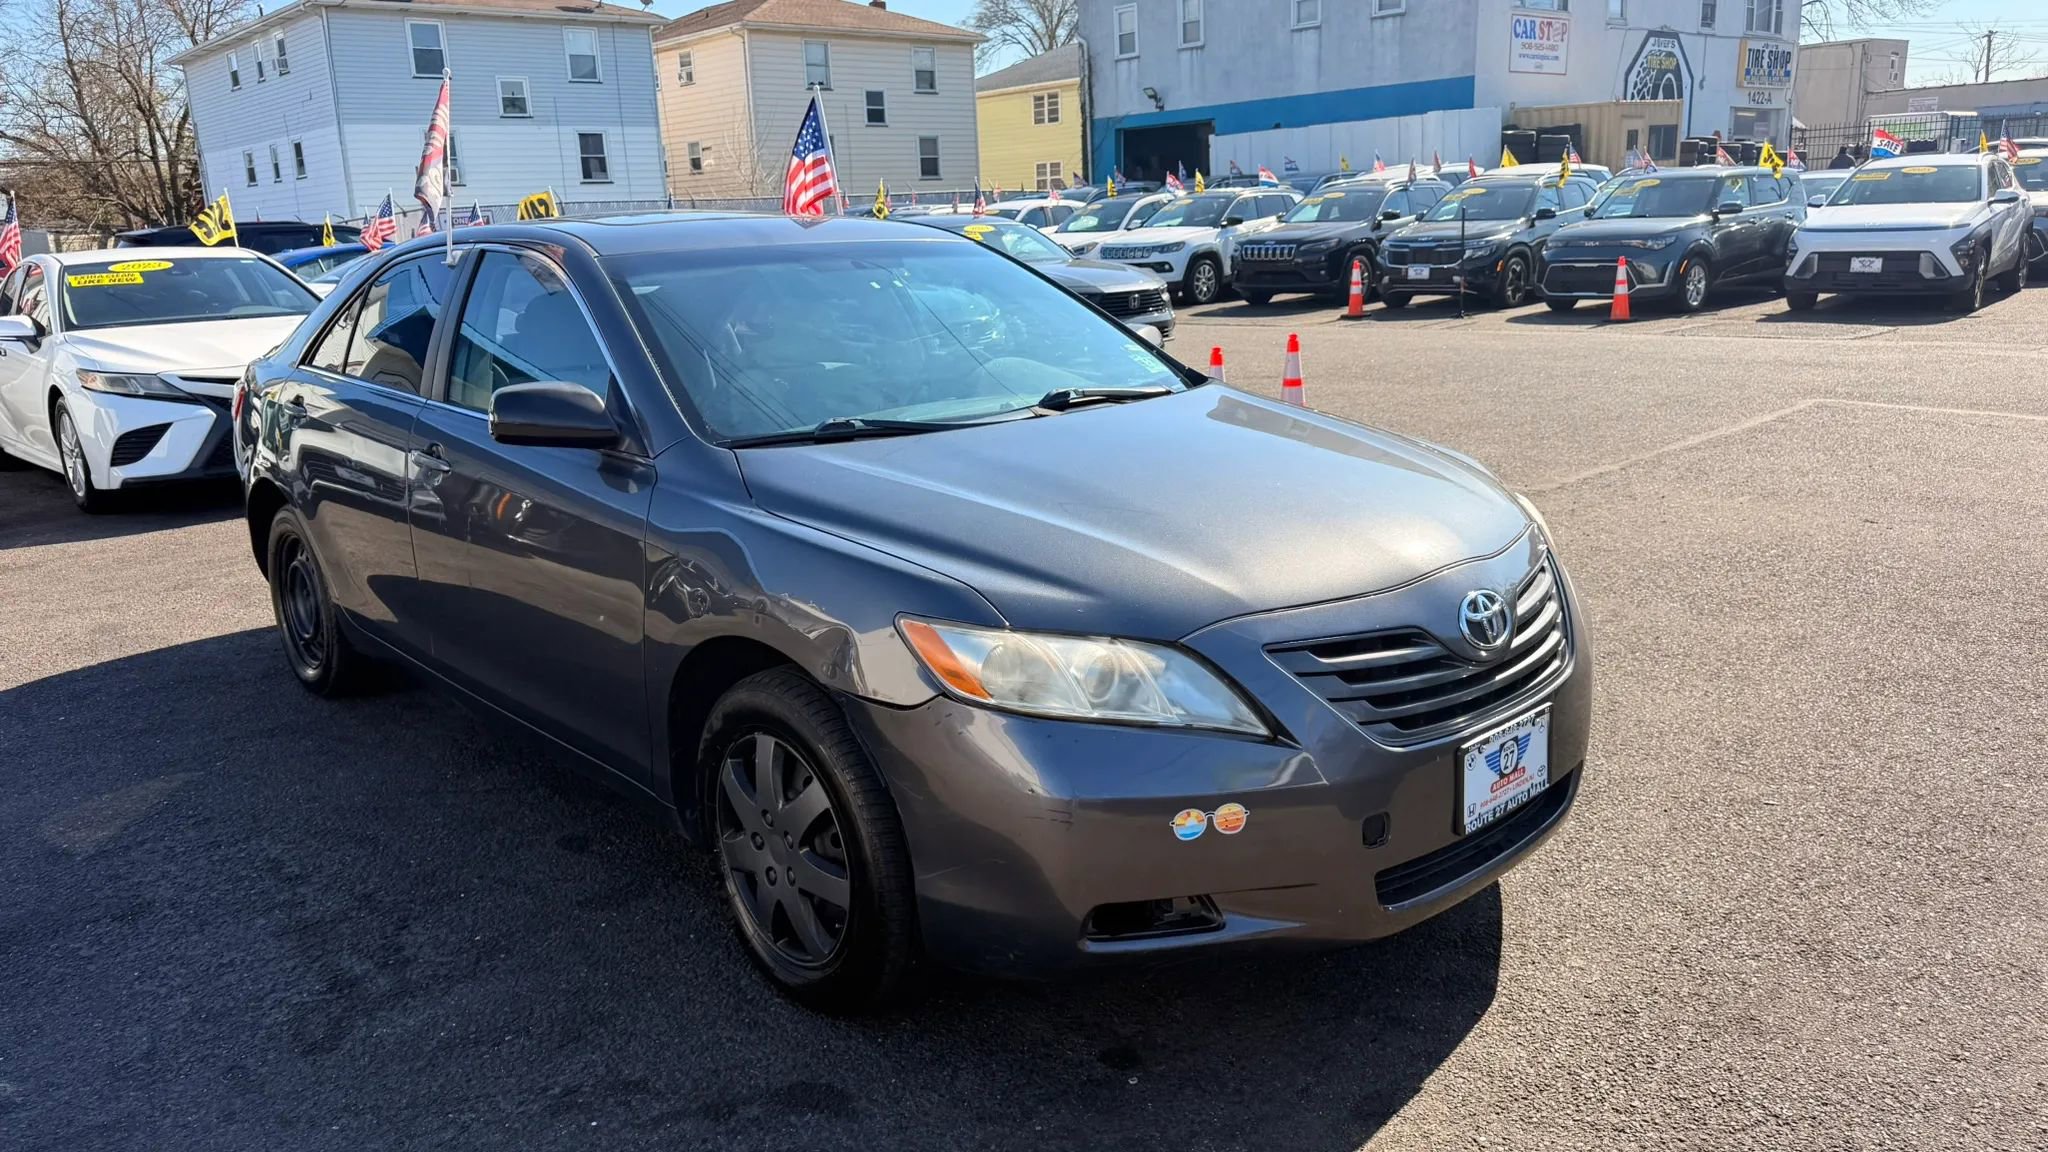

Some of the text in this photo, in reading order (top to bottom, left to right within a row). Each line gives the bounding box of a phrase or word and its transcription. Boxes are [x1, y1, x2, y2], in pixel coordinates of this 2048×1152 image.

[1513, 18, 1537, 40] CAR
[1647, 55, 1677, 70] TIRE SHOP
[1747, 48, 1792, 69] TIRE SHOP
[1747, 91, 1773, 105] 1422-A
[1876, 139, 1900, 153] SALE
[1503, 749, 1515, 771] 27
[1492, 768, 1525, 792] AUTO MALL
[1465, 782, 1549, 835] ROUTE 27 AUTO MALL
